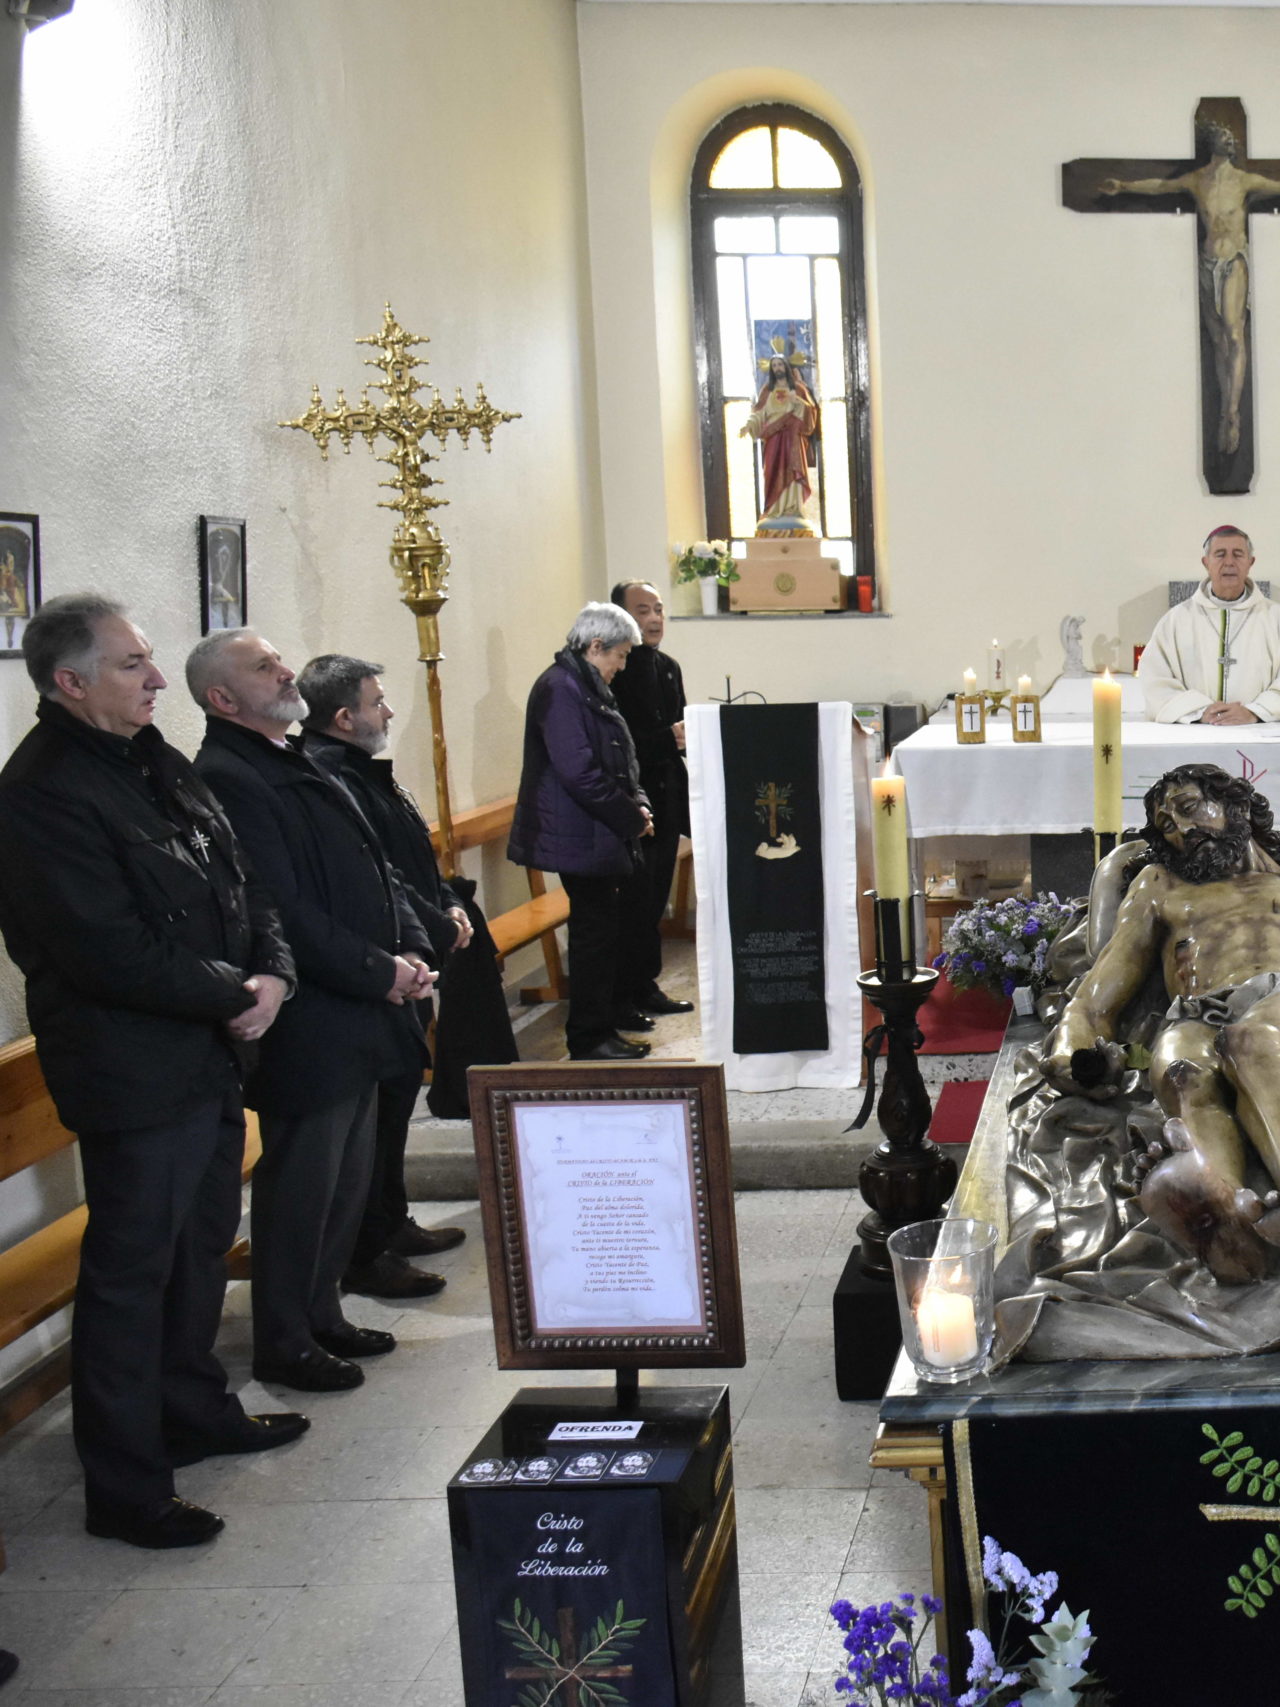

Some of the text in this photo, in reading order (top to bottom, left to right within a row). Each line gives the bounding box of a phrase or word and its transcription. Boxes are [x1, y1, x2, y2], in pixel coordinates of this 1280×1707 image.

[557, 1424, 634, 1433] OFRENDA
[536, 1512, 584, 1530] Cristo
[537, 1537, 585, 1553] de la
[517, 1558, 610, 1577] Liberación
